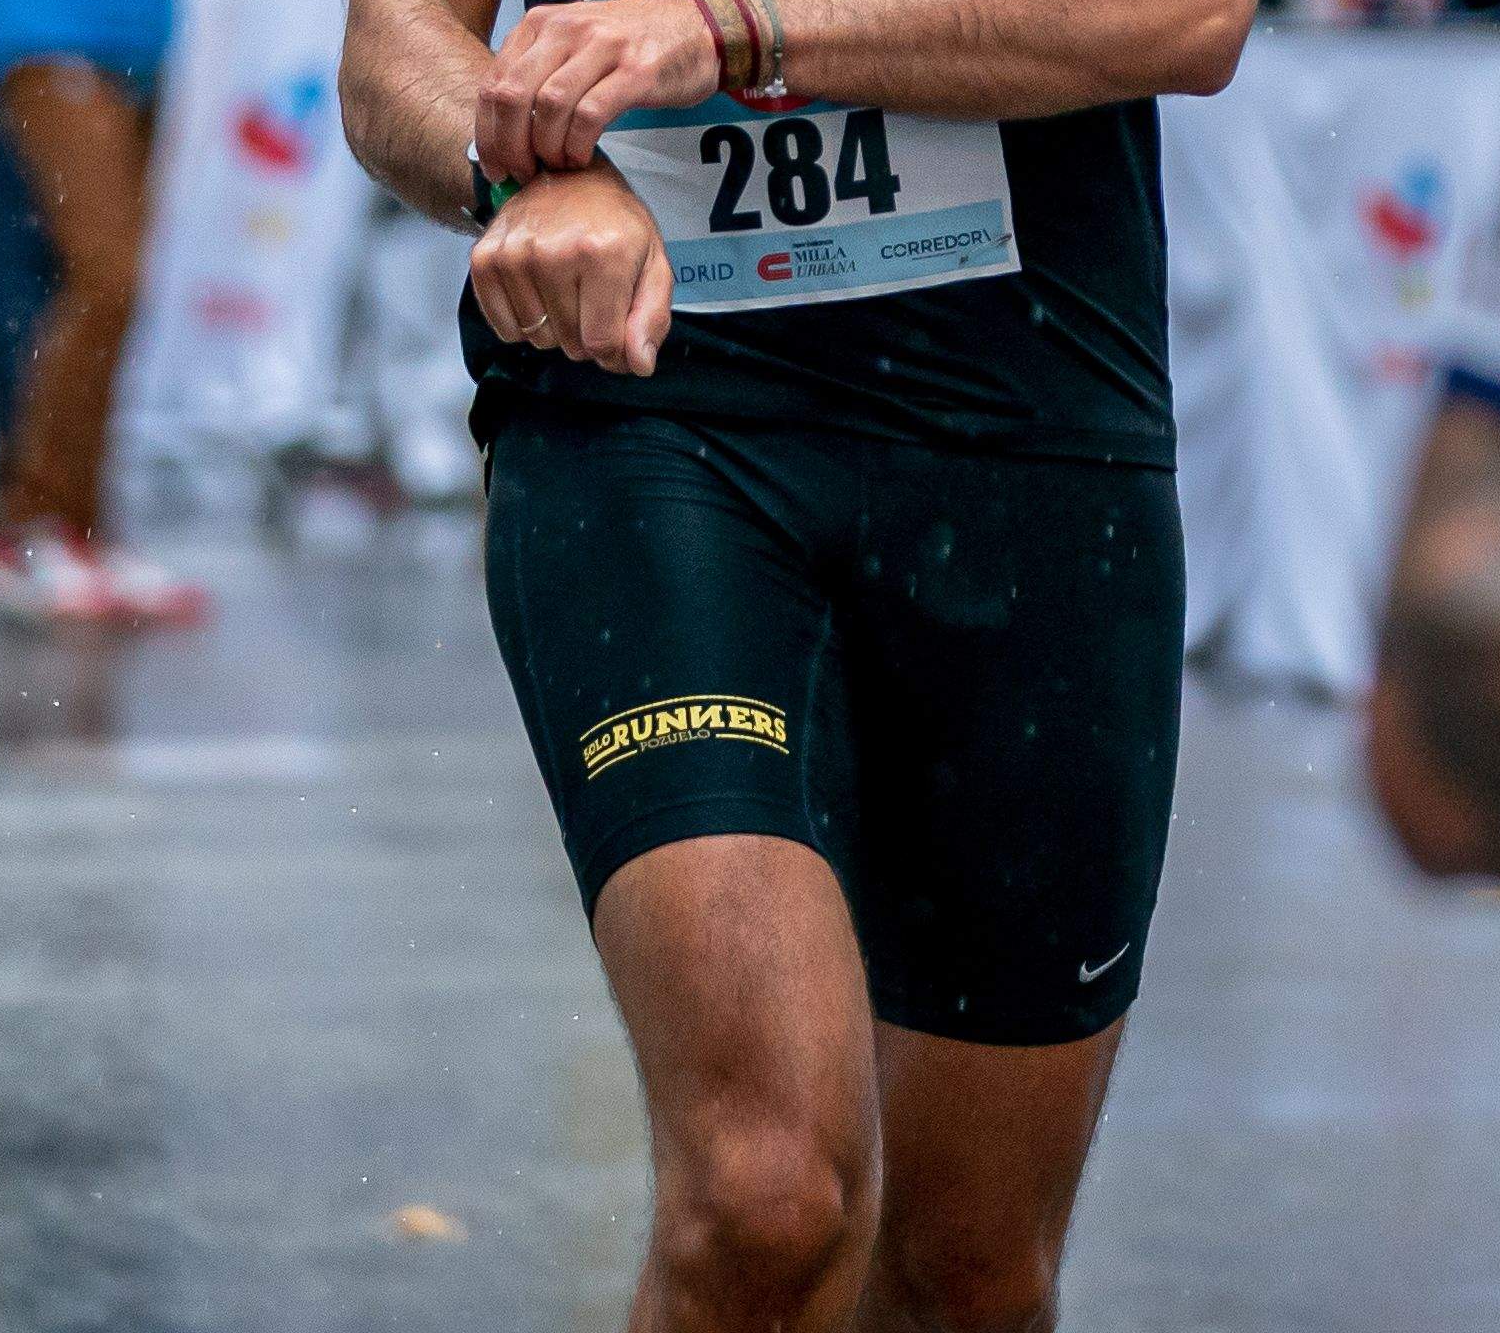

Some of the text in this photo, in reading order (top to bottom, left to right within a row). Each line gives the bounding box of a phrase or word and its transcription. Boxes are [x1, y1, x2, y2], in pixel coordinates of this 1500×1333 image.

[699, 108, 901, 233] 284
[793, 246, 847, 264] MILLA
[796, 259, 858, 279] URBANA
[583, 704, 787, 761] SOLO RUNNERS
[640, 728, 711, 753] POZUELO
